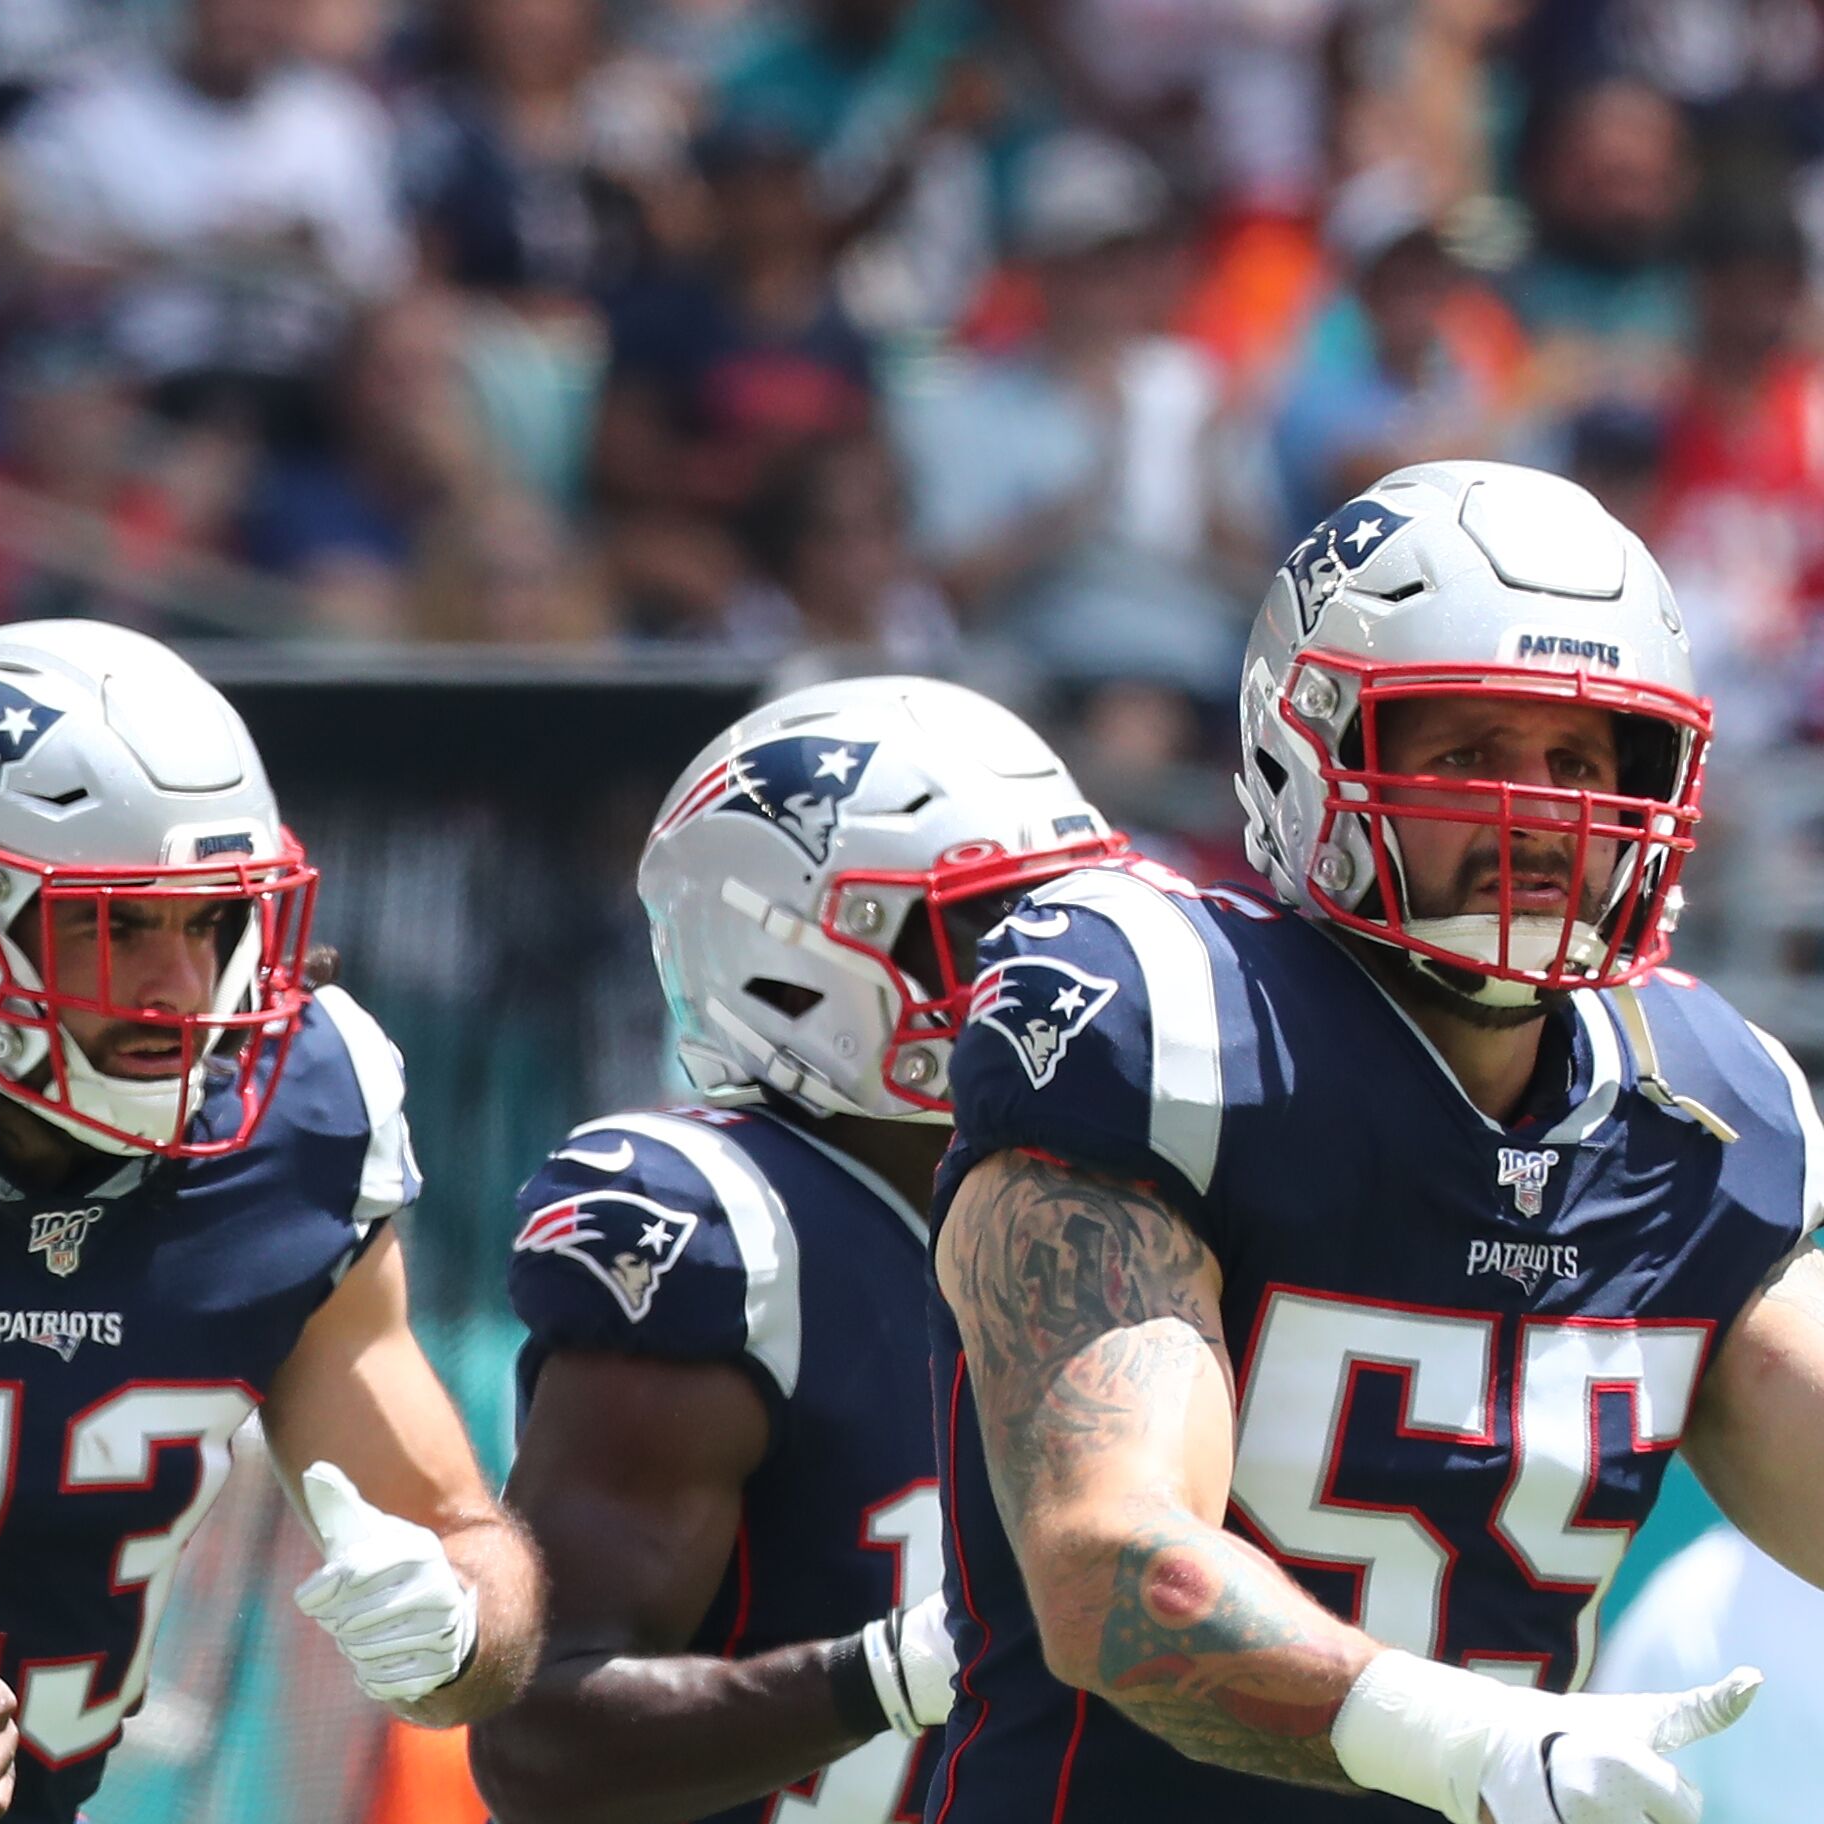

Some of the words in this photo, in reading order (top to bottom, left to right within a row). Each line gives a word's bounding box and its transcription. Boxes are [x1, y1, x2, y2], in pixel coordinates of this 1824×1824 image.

[1520, 634, 1620, 669] PATRIOTS
[1466, 1240, 1579, 1280] PATRIOTS
[1229, 1282, 1716, 1693] 55
